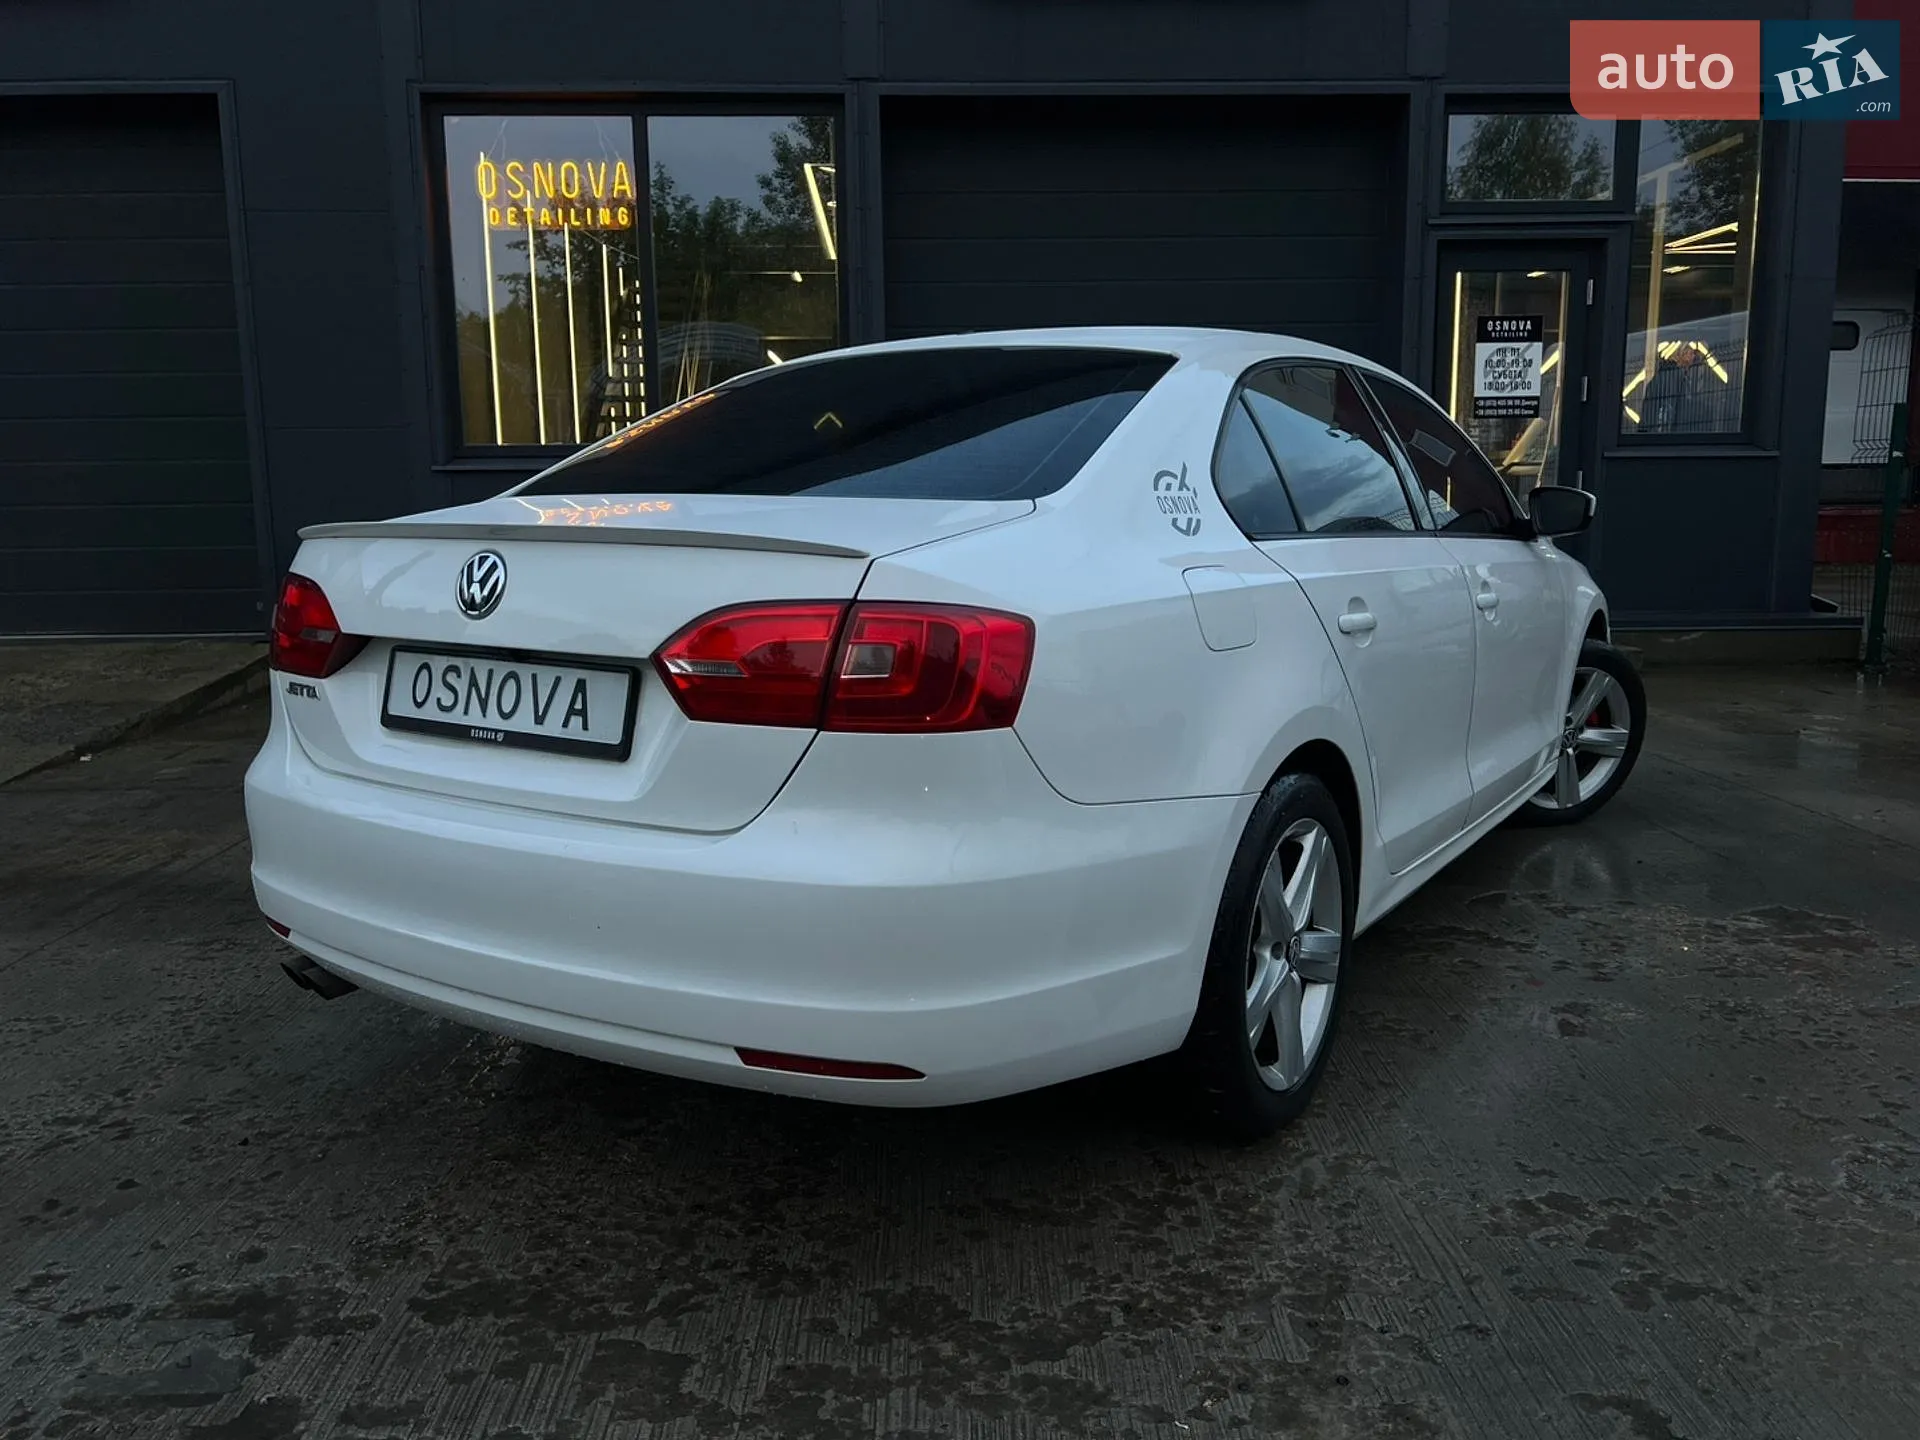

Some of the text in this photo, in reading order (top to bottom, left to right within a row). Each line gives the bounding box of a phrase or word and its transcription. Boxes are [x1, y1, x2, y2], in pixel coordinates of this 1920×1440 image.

[477, 161, 633, 200] OSNOVA
[489, 206, 629, 227] DETAILING
[1487, 319, 1532, 332] OSNOVA
[1156, 495, 1201, 515] OSNOVA
[286, 681, 321, 701] JETTA
[412, 661, 590, 732] OSNOVA
